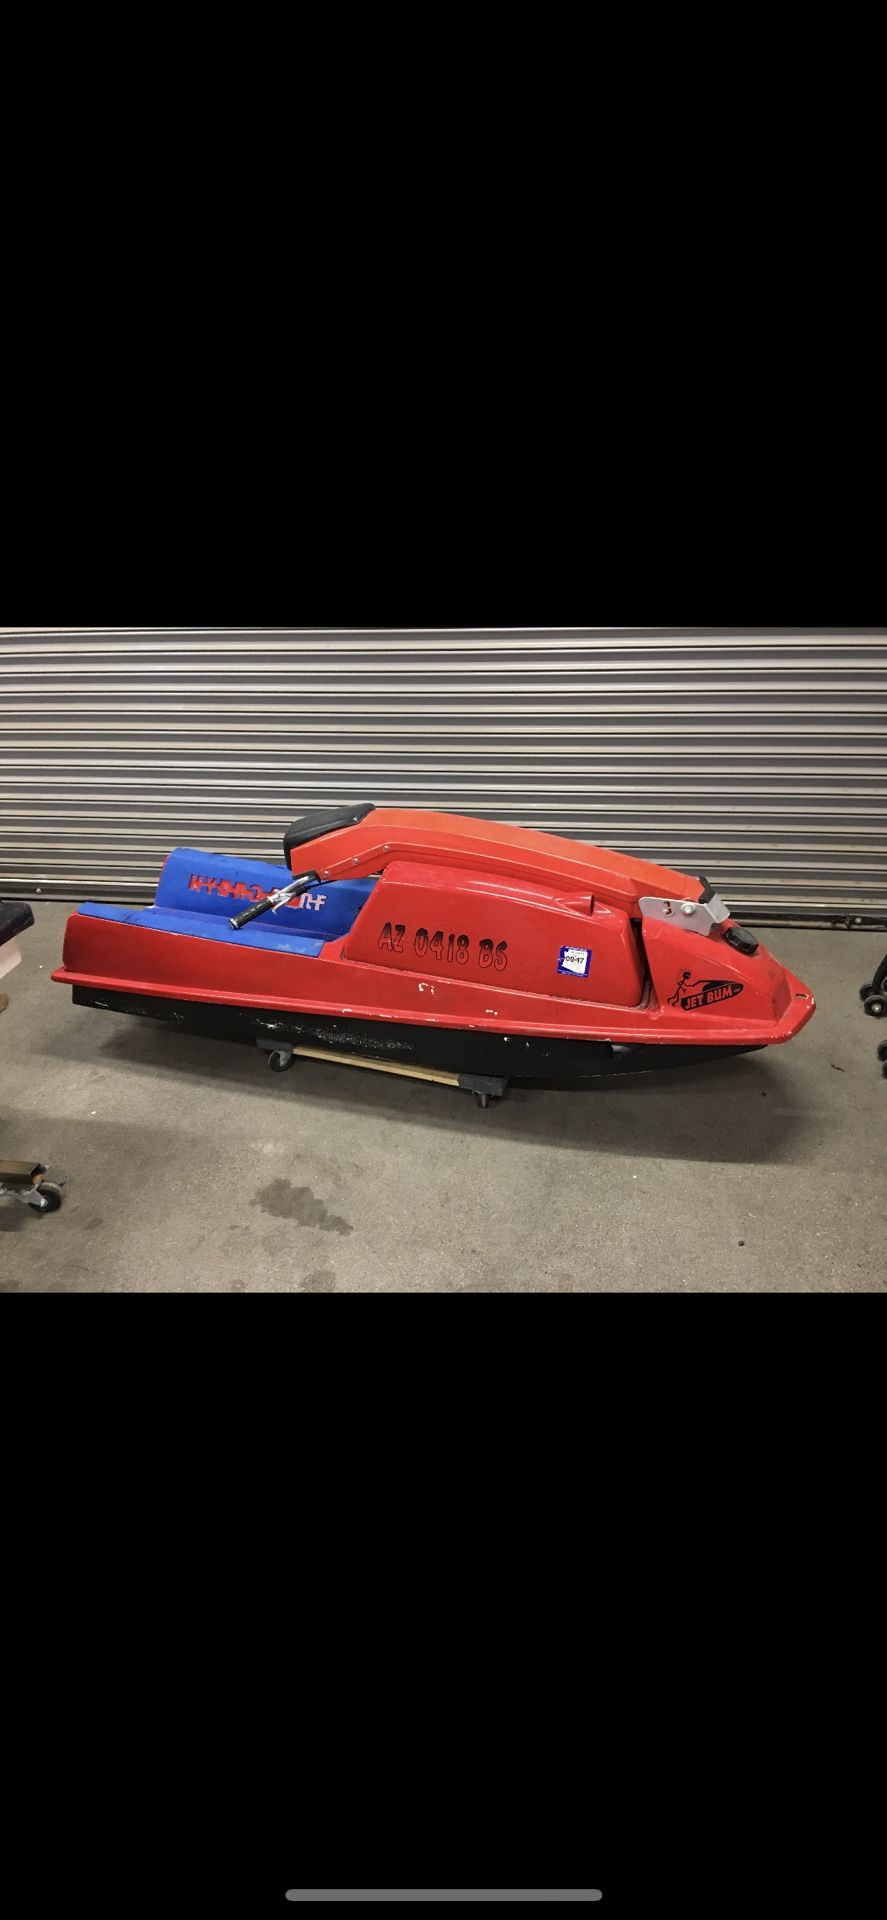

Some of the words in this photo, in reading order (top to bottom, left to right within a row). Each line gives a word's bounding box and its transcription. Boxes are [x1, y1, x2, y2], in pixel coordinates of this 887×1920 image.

[378, 922, 406, 953] AZ
[414, 928, 470, 965] 0418
[478, 938, 508, 971] BS
[685, 994, 704, 1009] JET
[706, 985, 733, 1003] BUM
